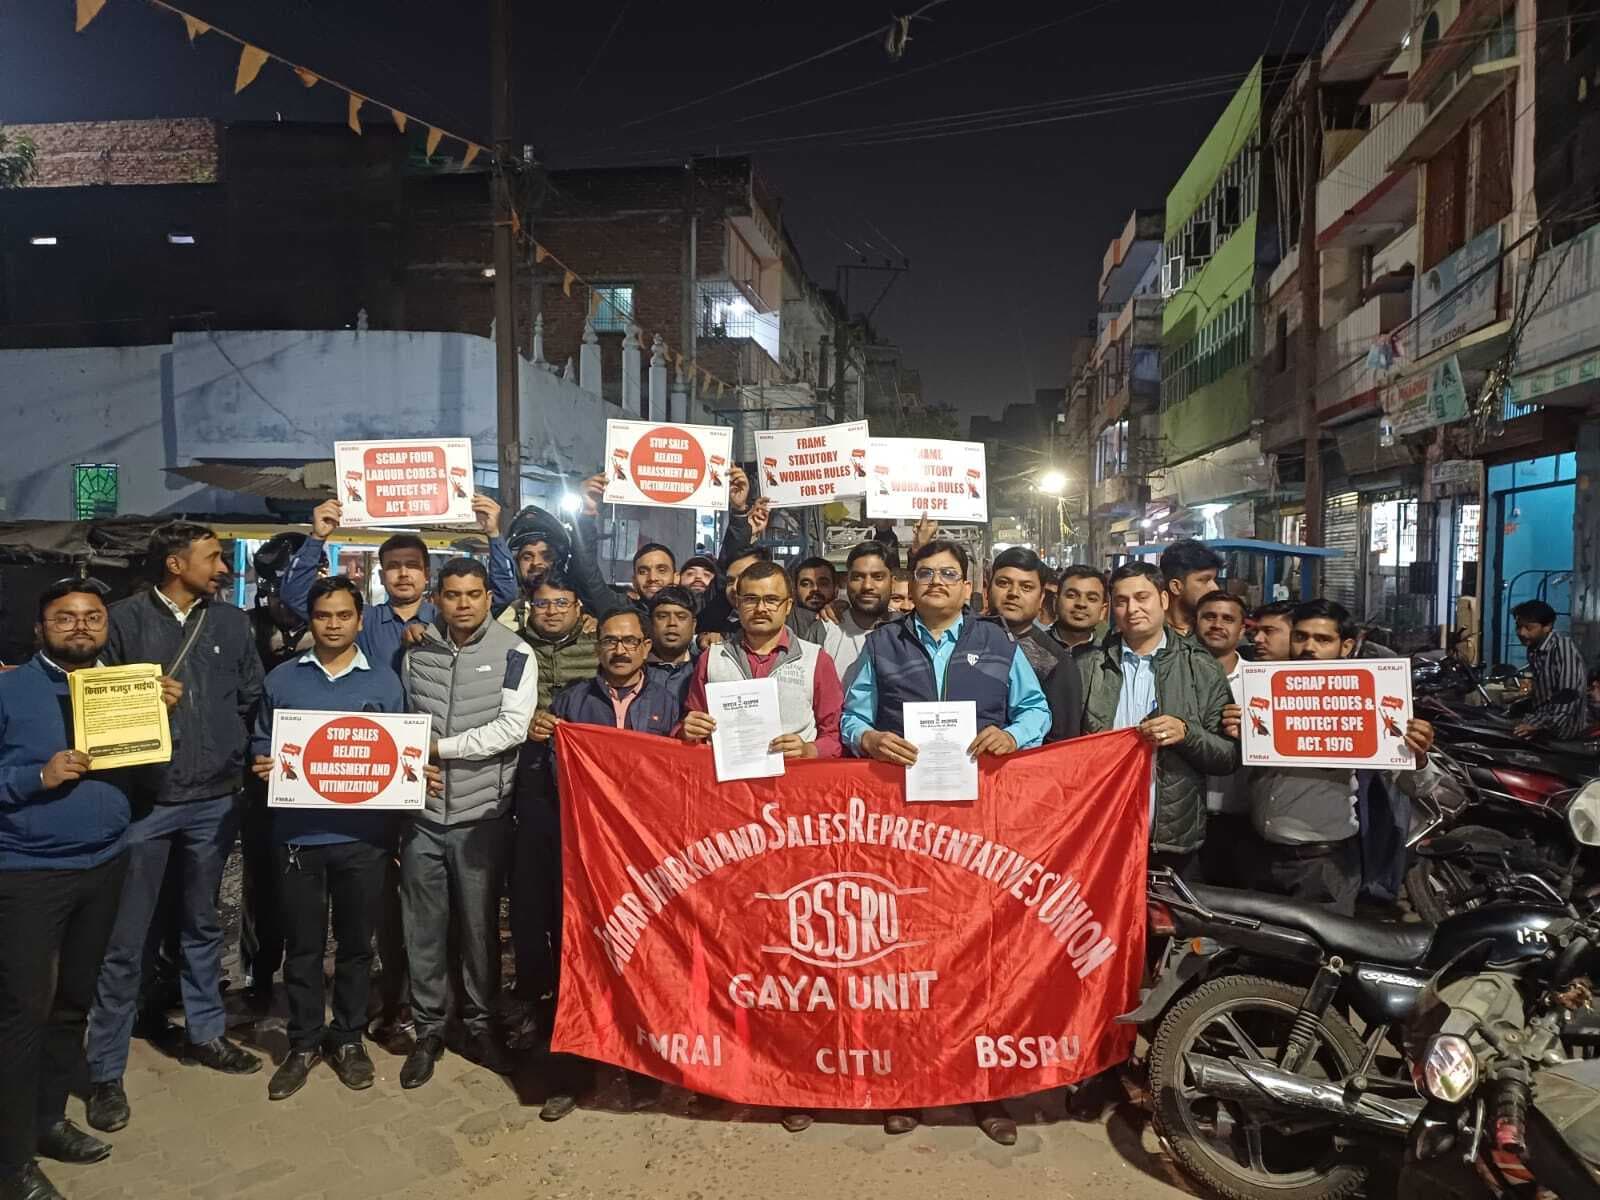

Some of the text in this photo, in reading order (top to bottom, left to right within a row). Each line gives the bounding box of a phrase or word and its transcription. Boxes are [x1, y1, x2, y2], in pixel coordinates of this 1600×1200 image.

[650, 437, 689, 450] STOP SALES
[797, 435, 827, 449] FRAME
[376, 451, 434, 464] SCRAP FOUR
[788, 450, 838, 466] STATUTORY
[366, 468, 405, 480] LABOUR
[406, 467, 437, 479] CODES
[779, 465, 851, 483] WORKING RULES
[376, 483, 438, 496] PROTECT SPE
[800, 483, 836, 497] FOR SPE
[938, 481, 965, 494] RULES
[407, 500, 431, 512] 1976
[912, 497, 948, 510] FOR SPE
[1286, 675, 1360, 690] SCRAP FOUR
[1274, 696, 1375, 711] LABOUR CODES &
[1285, 716, 1364, 731] PROTECT SPE
[327, 727, 379, 741] STOP SALES
[333, 745, 371, 758] RELATED
[1297, 737, 1354, 752] ACT. 1976
[310, 762, 391, 776] HARASSMENT AND
[626, 822, 768, 913] JHARKHAND
[762, 801, 848, 850] SALES
[1038, 874, 1118, 980] UNION
[788, 881, 900, 960] BSSRU
[728, 970, 938, 1013] GAYA UNIT
[636, 1024, 721, 1067] FMRAI
[975, 1035, 1081, 1069] BSSRU
[816, 1048, 892, 1076] CITU
